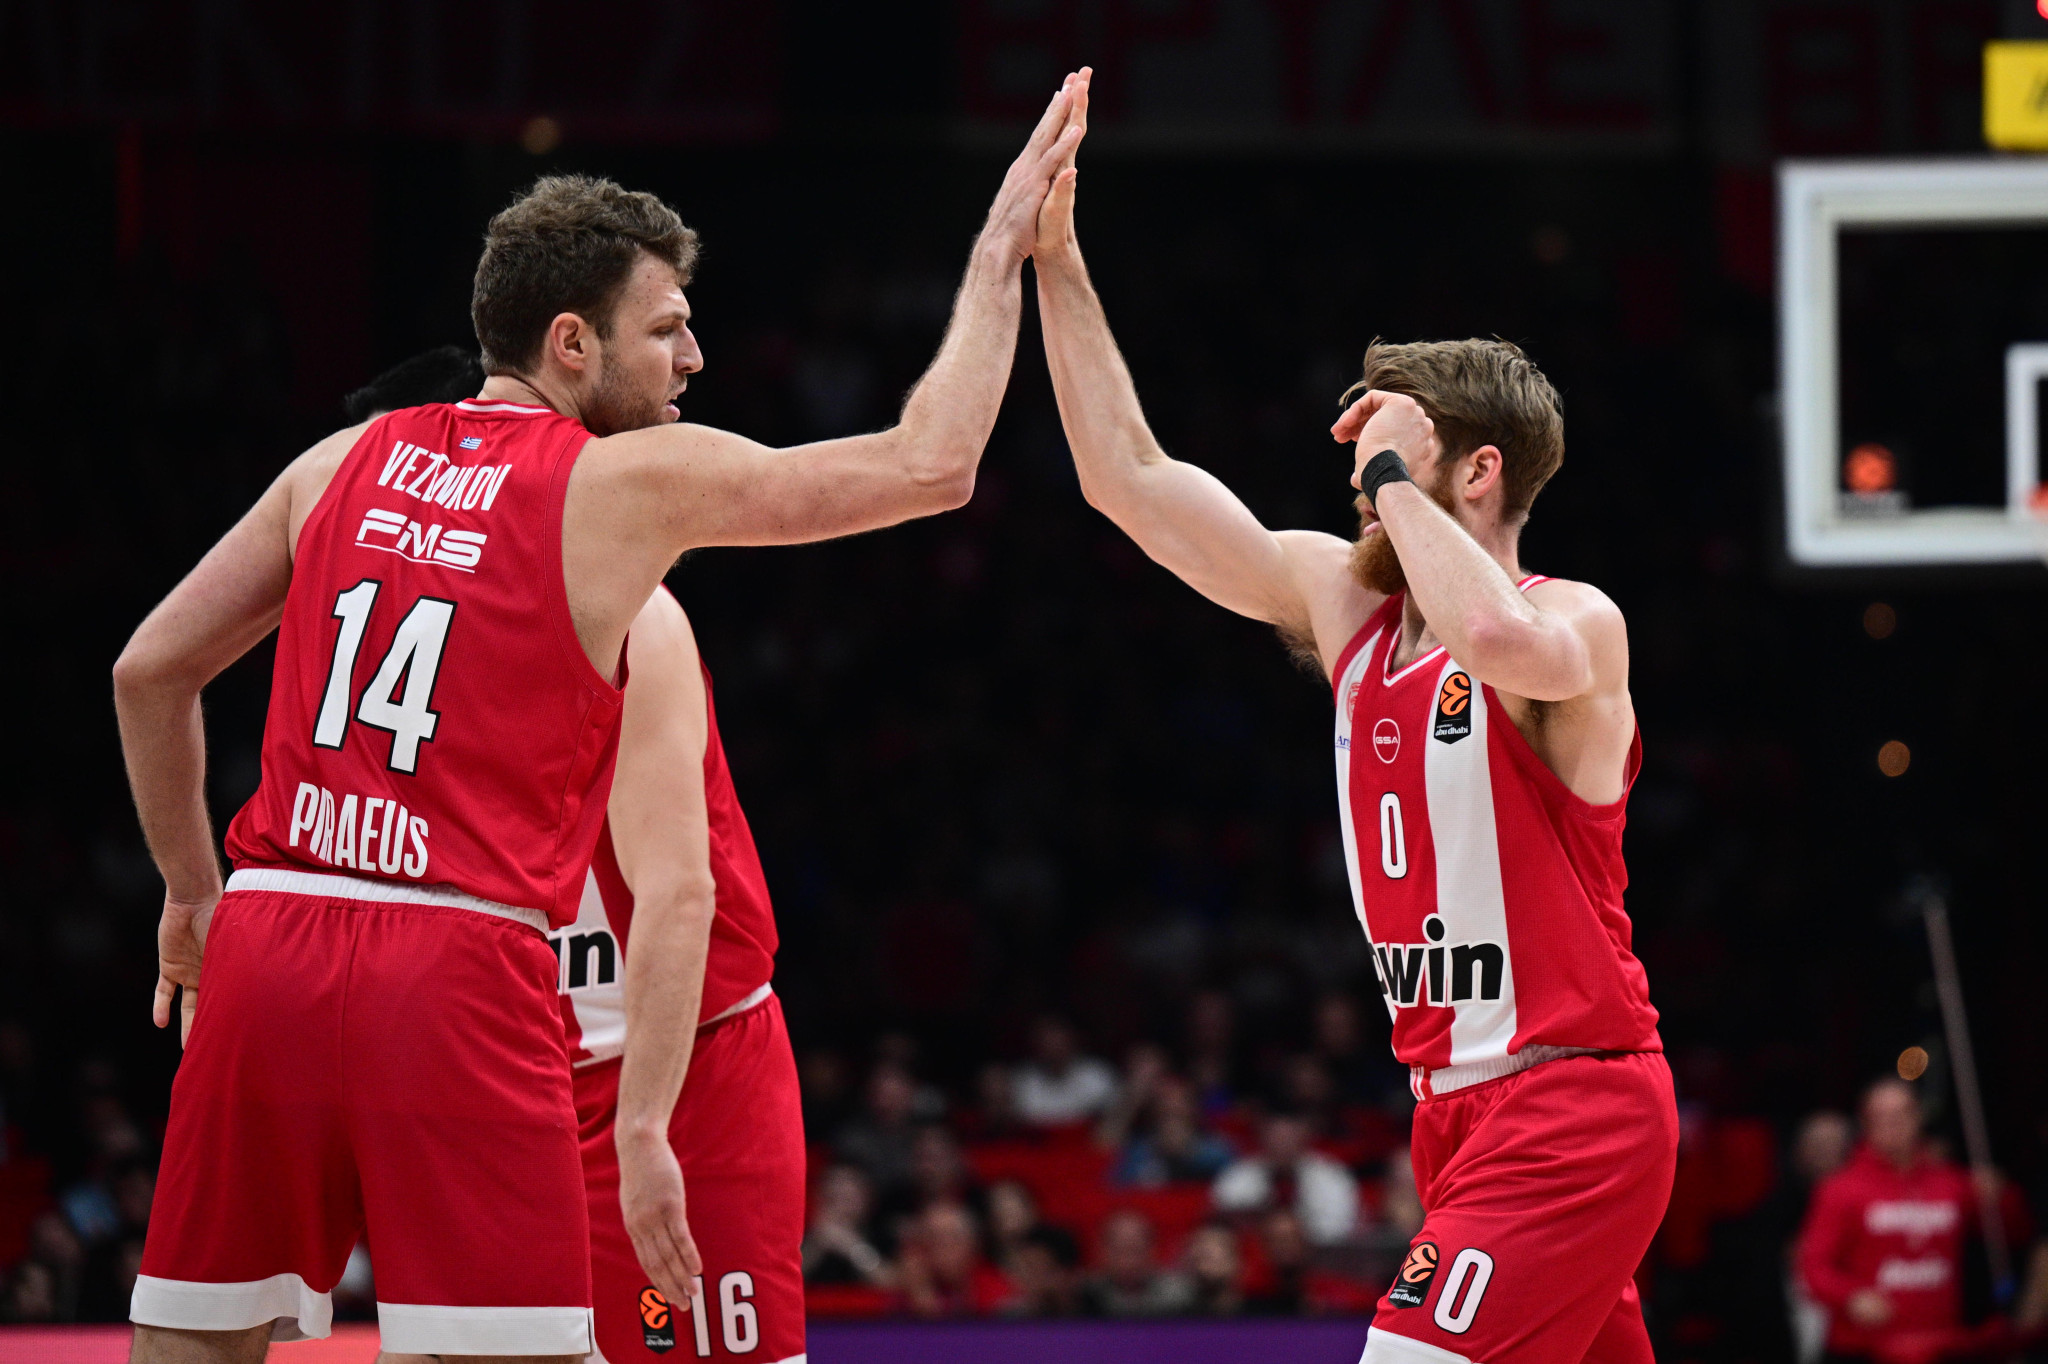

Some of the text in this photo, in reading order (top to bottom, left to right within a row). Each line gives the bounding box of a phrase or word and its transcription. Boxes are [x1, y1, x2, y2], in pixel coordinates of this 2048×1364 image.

[356, 508, 488, 567] FMS
[313, 578, 458, 777] 14
[1375, 736, 1399, 745] GSA
[289, 782, 429, 878] PIRAEUS
[1380, 792, 1408, 879] 0
[683, 1270, 760, 1358] 16
[1434, 1247, 1495, 1335] 0
